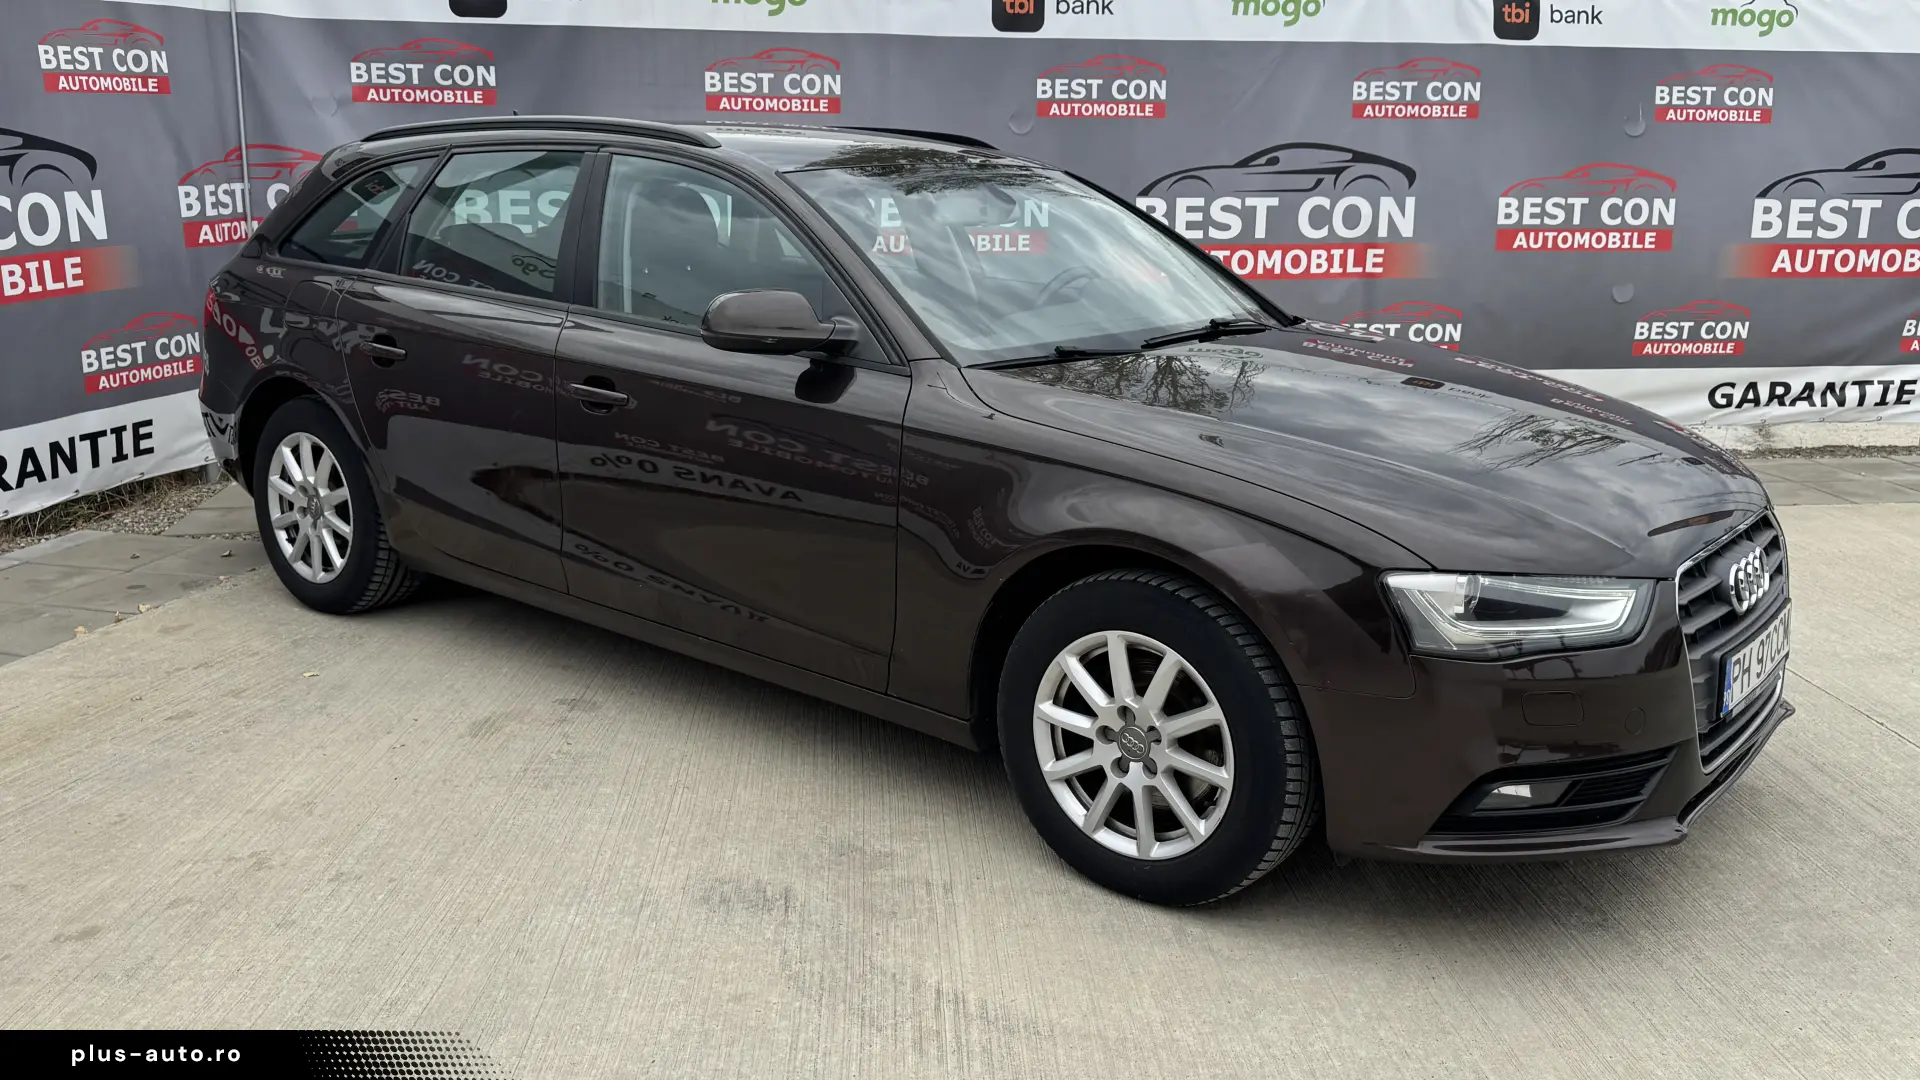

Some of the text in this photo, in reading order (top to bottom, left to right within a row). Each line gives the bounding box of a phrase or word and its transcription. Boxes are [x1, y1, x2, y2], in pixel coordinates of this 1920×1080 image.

[1502, 3, 1603, 25] tbi bank
[1711, 7, 1795, 37] mogo
[38, 44, 169, 75] BEST CON
[57, 76, 158, 93] AUTOMOBILE
[350, 62, 496, 87] BEST CON
[704, 71, 841, 95] BEST CON
[367, 88, 484, 104] AUTOMOBILE
[1036, 78, 1166, 100] BEST CON
[1353, 81, 1481, 102] BEST CON
[1655, 85, 1774, 107] BEST CON
[719, 98, 829, 113] AUTOMOBILE
[1049, 103, 1154, 117] AUTOMOBILE
[1363, 104, 1467, 119] AUTOMOBILE
[1665, 109, 1761, 122] AUTOMOBILE
[1297, 196, 1416, 239] CON
[1496, 196, 1677, 227] BEST CON
[1750, 198, 1883, 239] BEST
[1513, 232, 1656, 249] AUTOMOBILE
[1408, 323, 1462, 343] CON
[1633, 319, 1750, 341] BEST CON
[81, 341, 147, 374] BEST
[155, 331, 200, 361] CON
[1641, 343, 1735, 356] AUTOMOBILE
[98, 359, 195, 390] AUTOMOBILE
[1707, 379, 1918, 409] GARANTIE
